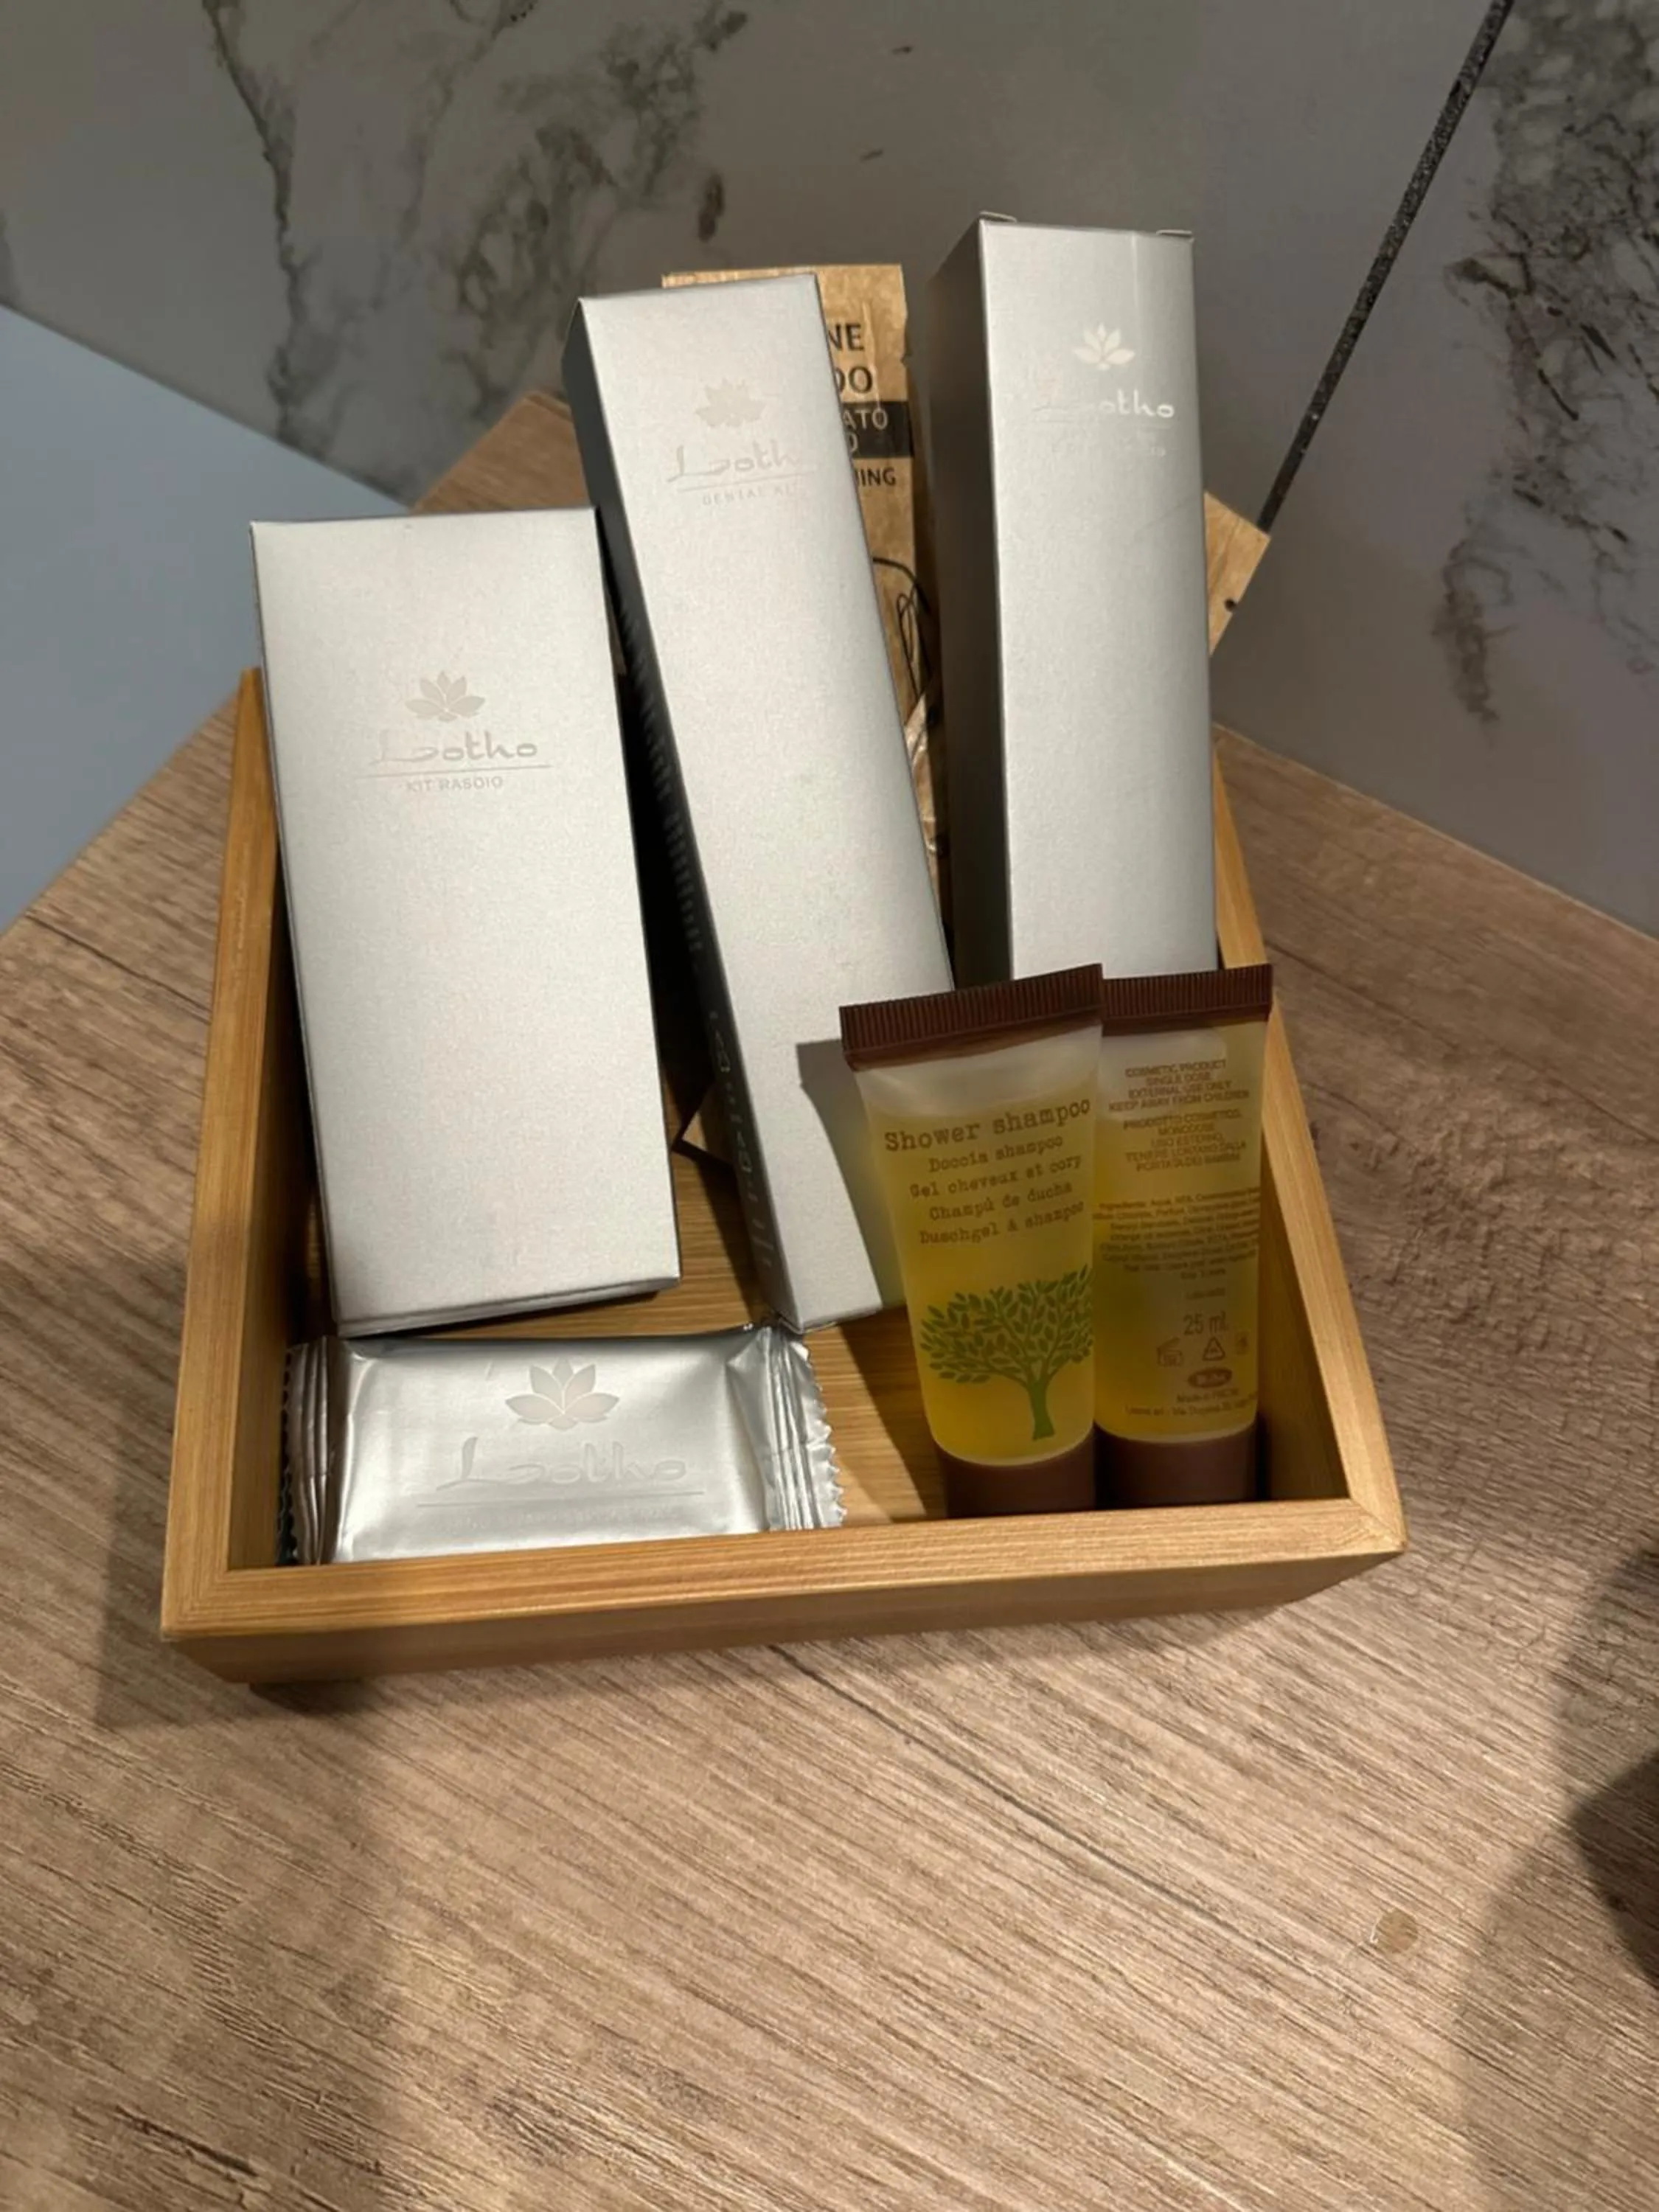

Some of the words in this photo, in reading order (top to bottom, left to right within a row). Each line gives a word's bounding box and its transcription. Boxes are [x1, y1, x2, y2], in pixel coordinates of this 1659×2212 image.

[855, 467, 897, 487] ING
[406, 779, 433, 793] KIT
[439, 776, 504, 790] RASOIO
[884, 1122, 981, 1152] Shower
[992, 1099, 1091, 1135] shampoo
[928, 1151, 989, 1172] Doccia
[995, 1135, 1064, 1161] shampoo
[909, 1180, 940, 1198] Gel
[947, 1169, 1019, 1194] cheveux
[1026, 1163, 1044, 1179] et
[1002, 1194, 1021, 1208] de
[1027, 1182, 1073, 1203] ducha
[919, 1221, 1001, 1245] Duschgel
[1183, 1312, 1204, 1335] 25
